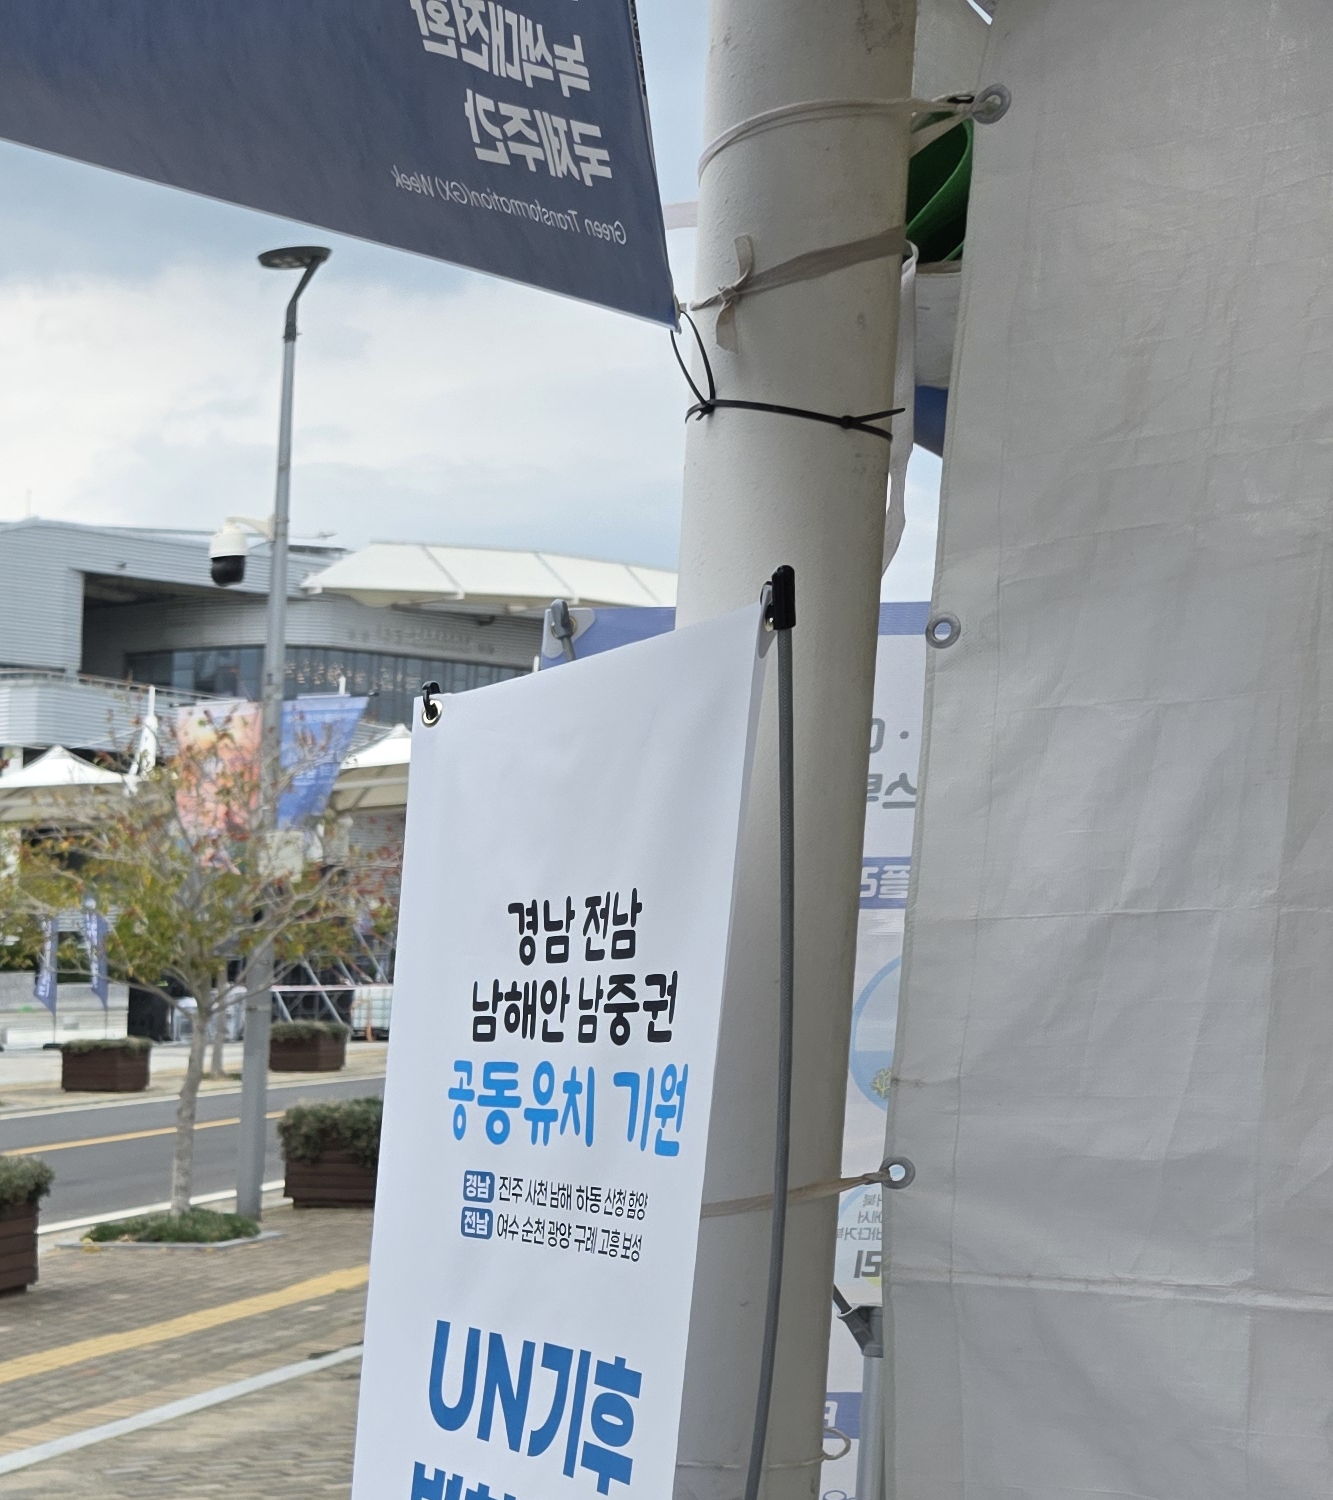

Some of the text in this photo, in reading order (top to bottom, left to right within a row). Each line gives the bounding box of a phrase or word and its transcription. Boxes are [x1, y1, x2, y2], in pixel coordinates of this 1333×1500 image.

[508, 888, 643, 966] 경남 전남
[472, 971, 678, 1045] 남해안 남중권
[448, 1060, 688, 1157] 공동유치 기원
[465, 1174, 648, 1220] 경남 진주 사천 남해 하동 산청 함양
[464, 1211, 643, 1262] 전남 여수 순천 광양 구례 고흥 보성
[428, 1319, 643, 1495] UN기후
